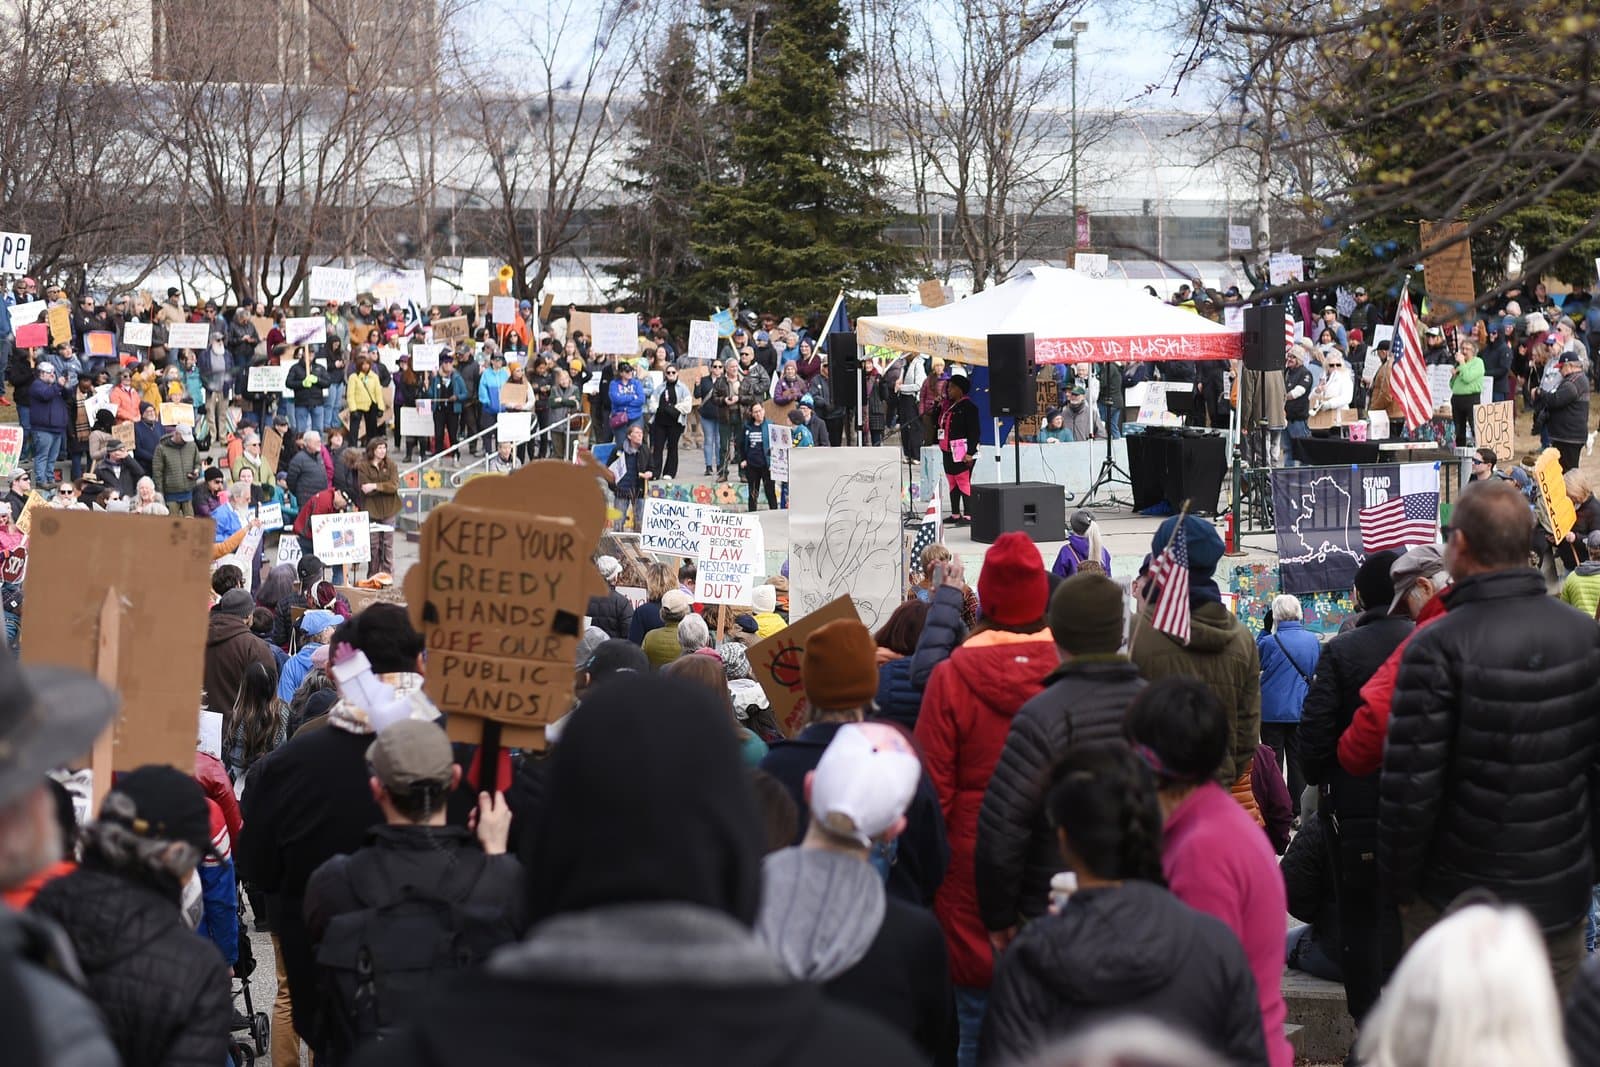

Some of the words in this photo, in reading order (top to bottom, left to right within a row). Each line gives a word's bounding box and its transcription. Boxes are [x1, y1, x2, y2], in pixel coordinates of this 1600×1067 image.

[1038, 339, 1095, 359] STAND
[1101, 338, 1123, 358] UP
[1130, 336, 1192, 360] ALASKA
[1476, 403, 1509, 424] OPEN
[1477, 421, 1510, 444] YOUR
[1480, 441, 1512, 460] ES
[1362, 476, 1391, 489] STAND
[1538, 471, 1562, 540] DONALD
[647, 517, 681, 530] HANDS
[711, 514, 743, 526] WHEN
[436, 512, 507, 557] KEEP
[515, 523, 575, 562] YOUR
[669, 530, 686, 538] OUR
[701, 525, 752, 539] INJUSTICE
[642, 534, 700, 552] DEMOCRAC
[709, 538, 743, 548] BECOMES
[709, 547, 743, 561] LAW
[699, 560, 752, 575] RESISTANCE
[432, 560, 562, 600] GREEDY
[705, 573, 741, 583] BECOMES
[703, 583, 743, 600] DUTY
[446, 598, 546, 627] HANDS
[431, 628, 484, 653] OFF
[500, 635, 562, 658] OUR
[443, 655, 549, 685] PUBLIC
